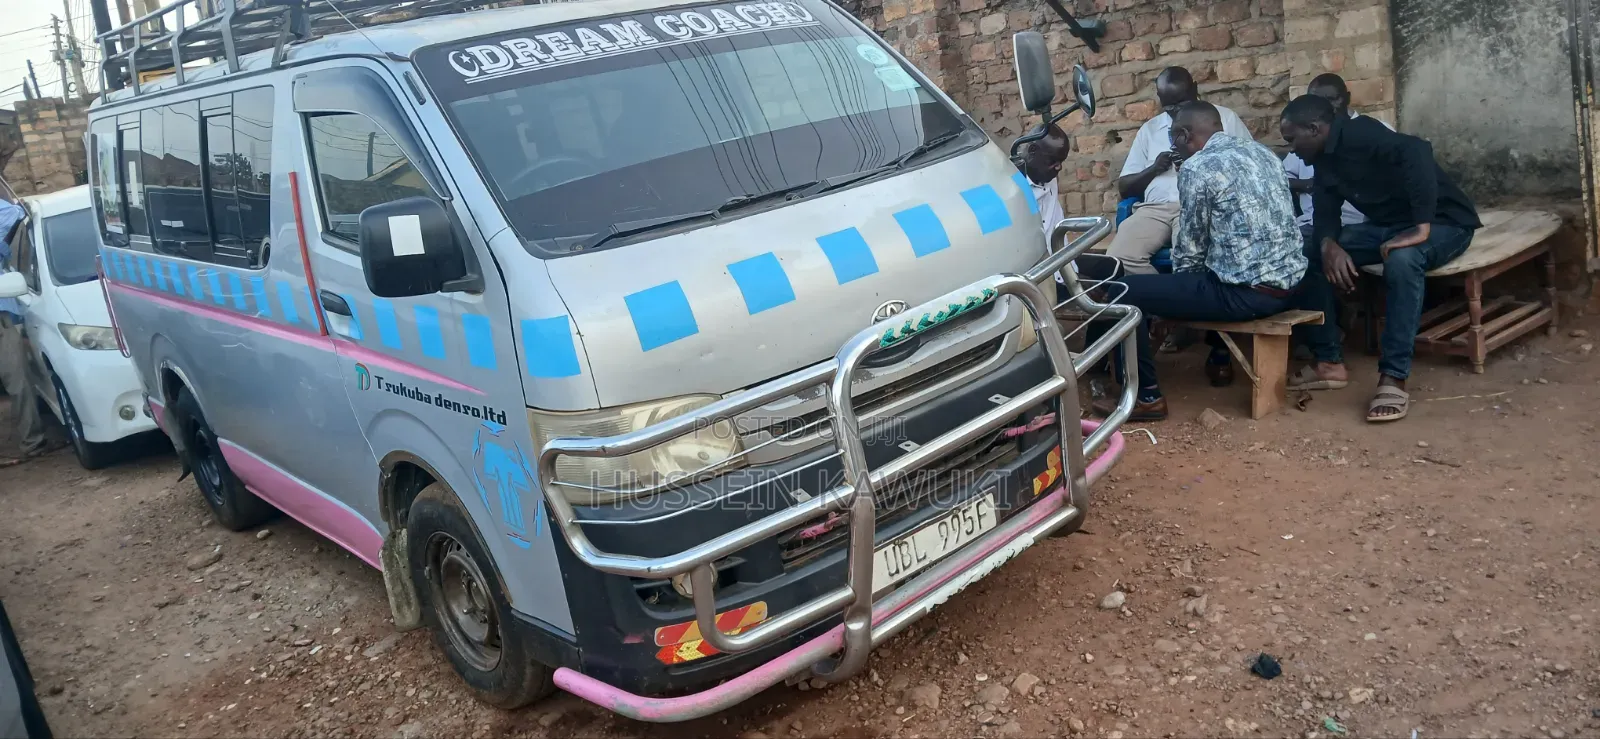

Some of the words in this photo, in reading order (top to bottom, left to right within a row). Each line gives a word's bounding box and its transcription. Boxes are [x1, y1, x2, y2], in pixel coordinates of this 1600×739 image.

[464, 19, 660, 74] DREAM
[653, 2, 801, 40] COACH
[883, 535, 927, 578] UBL
[937, 498, 987, 551] 995F
